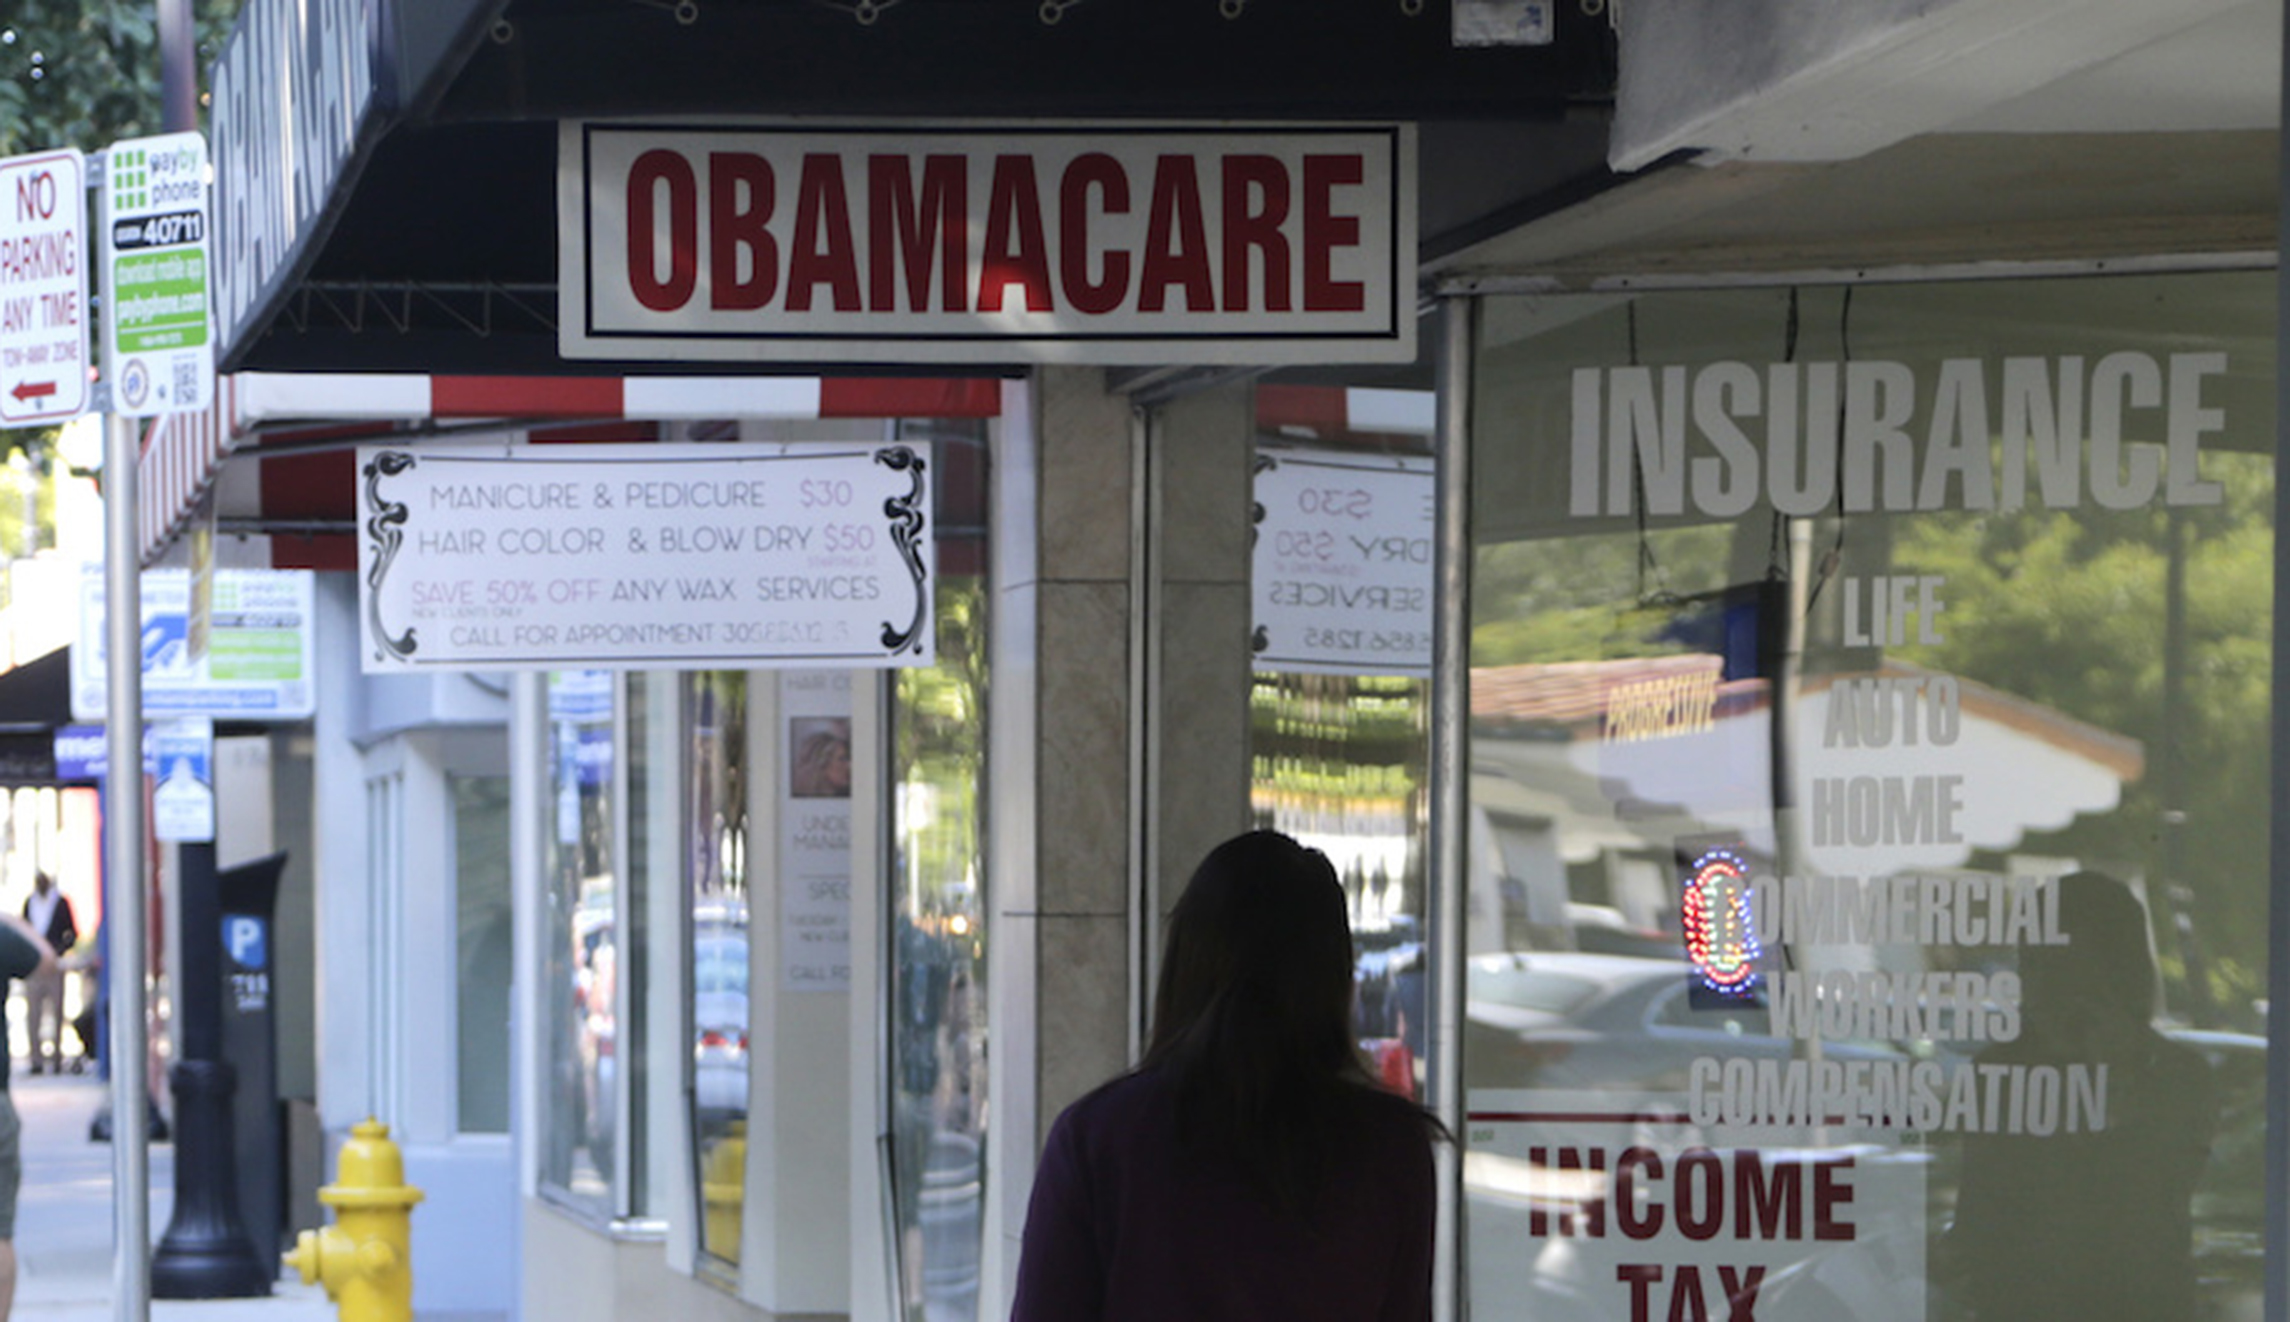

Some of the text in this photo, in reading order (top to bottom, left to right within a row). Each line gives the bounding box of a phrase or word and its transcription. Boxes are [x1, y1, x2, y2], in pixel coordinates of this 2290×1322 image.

[16, 171, 56, 223] NO
[152, 178, 200, 208] phone
[1, 230, 75, 285] PARKING
[143, 213, 201, 246] 40711
[626, 149, 1364, 314] OBAMACARE
[2, 290, 77, 333] ANY TIME
[1569, 351, 2228, 517] INSURANCE
[431, 479, 853, 510] MANICURE & PEDICURE $30
[419, 522, 875, 556] HAIR COLOR & BLOW DRY $50
[412, 574, 880, 605] SAVE 50% OFF ANY WAX SERVICES
[1843, 575, 1945, 648] LIFE
[450, 625, 506, 647] CALL
[514, 624, 558, 645] FOR
[564, 621, 714, 645] APPOINTMENT
[1823, 676, 1960, 750] AUTO
[1812, 774, 1963, 847] HOME
[1768, 970, 2022, 1043] WORKERS
[1688, 1055, 2108, 1137] COMPENSATION
[1529, 1146, 1856, 1240] INCOME
[1616, 1263, 1767, 1322] TAX
